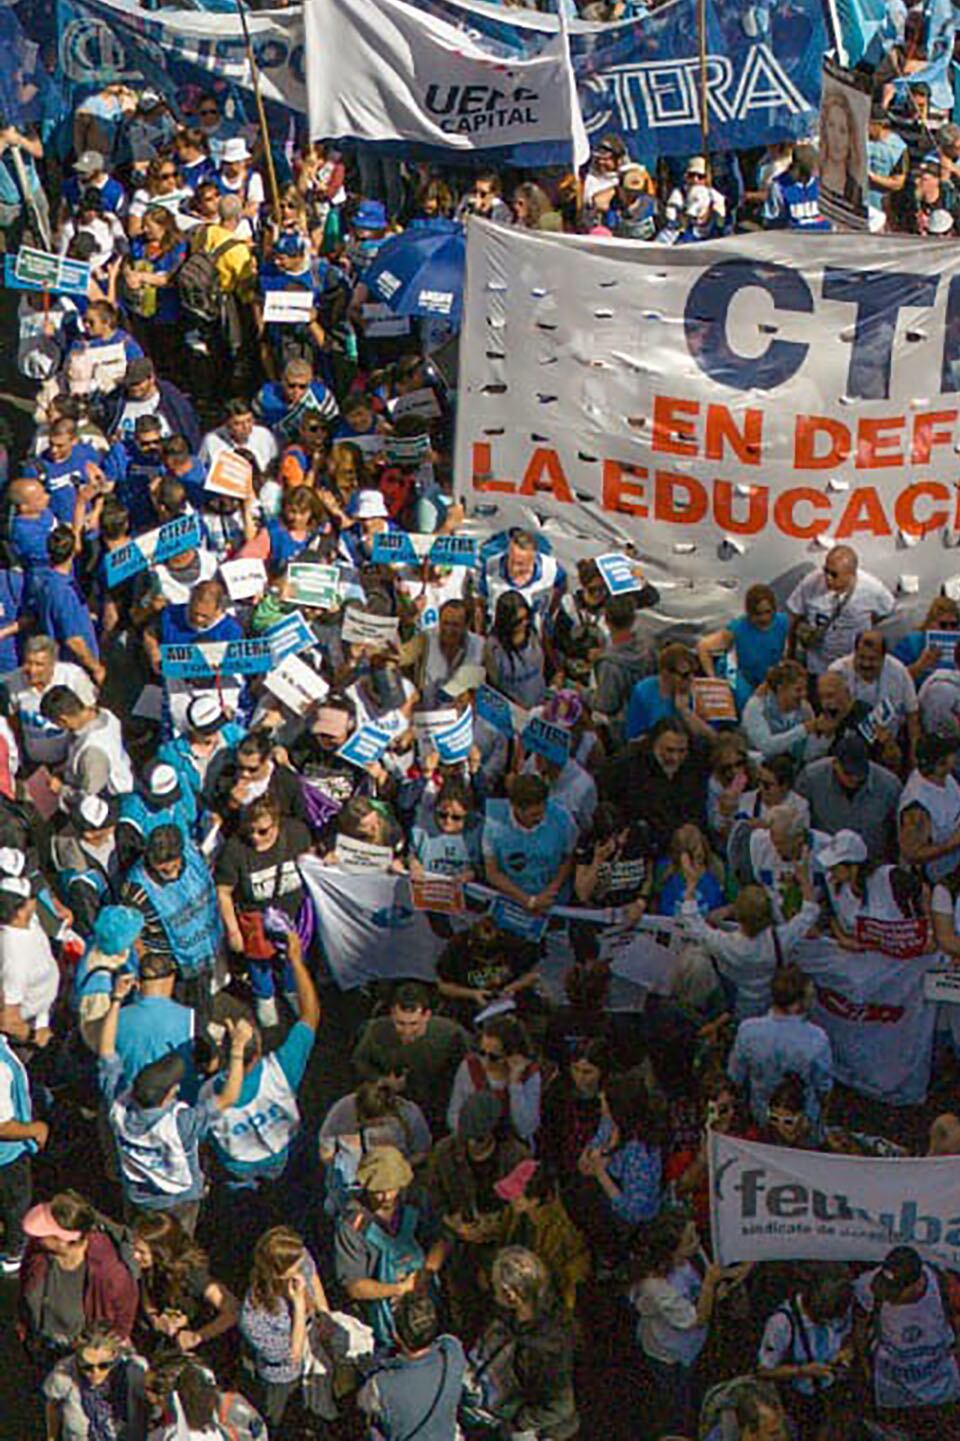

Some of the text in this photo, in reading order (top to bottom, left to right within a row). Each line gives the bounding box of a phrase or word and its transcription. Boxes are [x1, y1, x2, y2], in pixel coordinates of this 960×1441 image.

[440, 107, 540, 134] CAPITAL
[651, 395, 764, 466] EN
[471, 442, 575, 504] LA
[167, 639, 272, 662] ADF CTERA
[740, 1220, 812, 1237] sindicato
